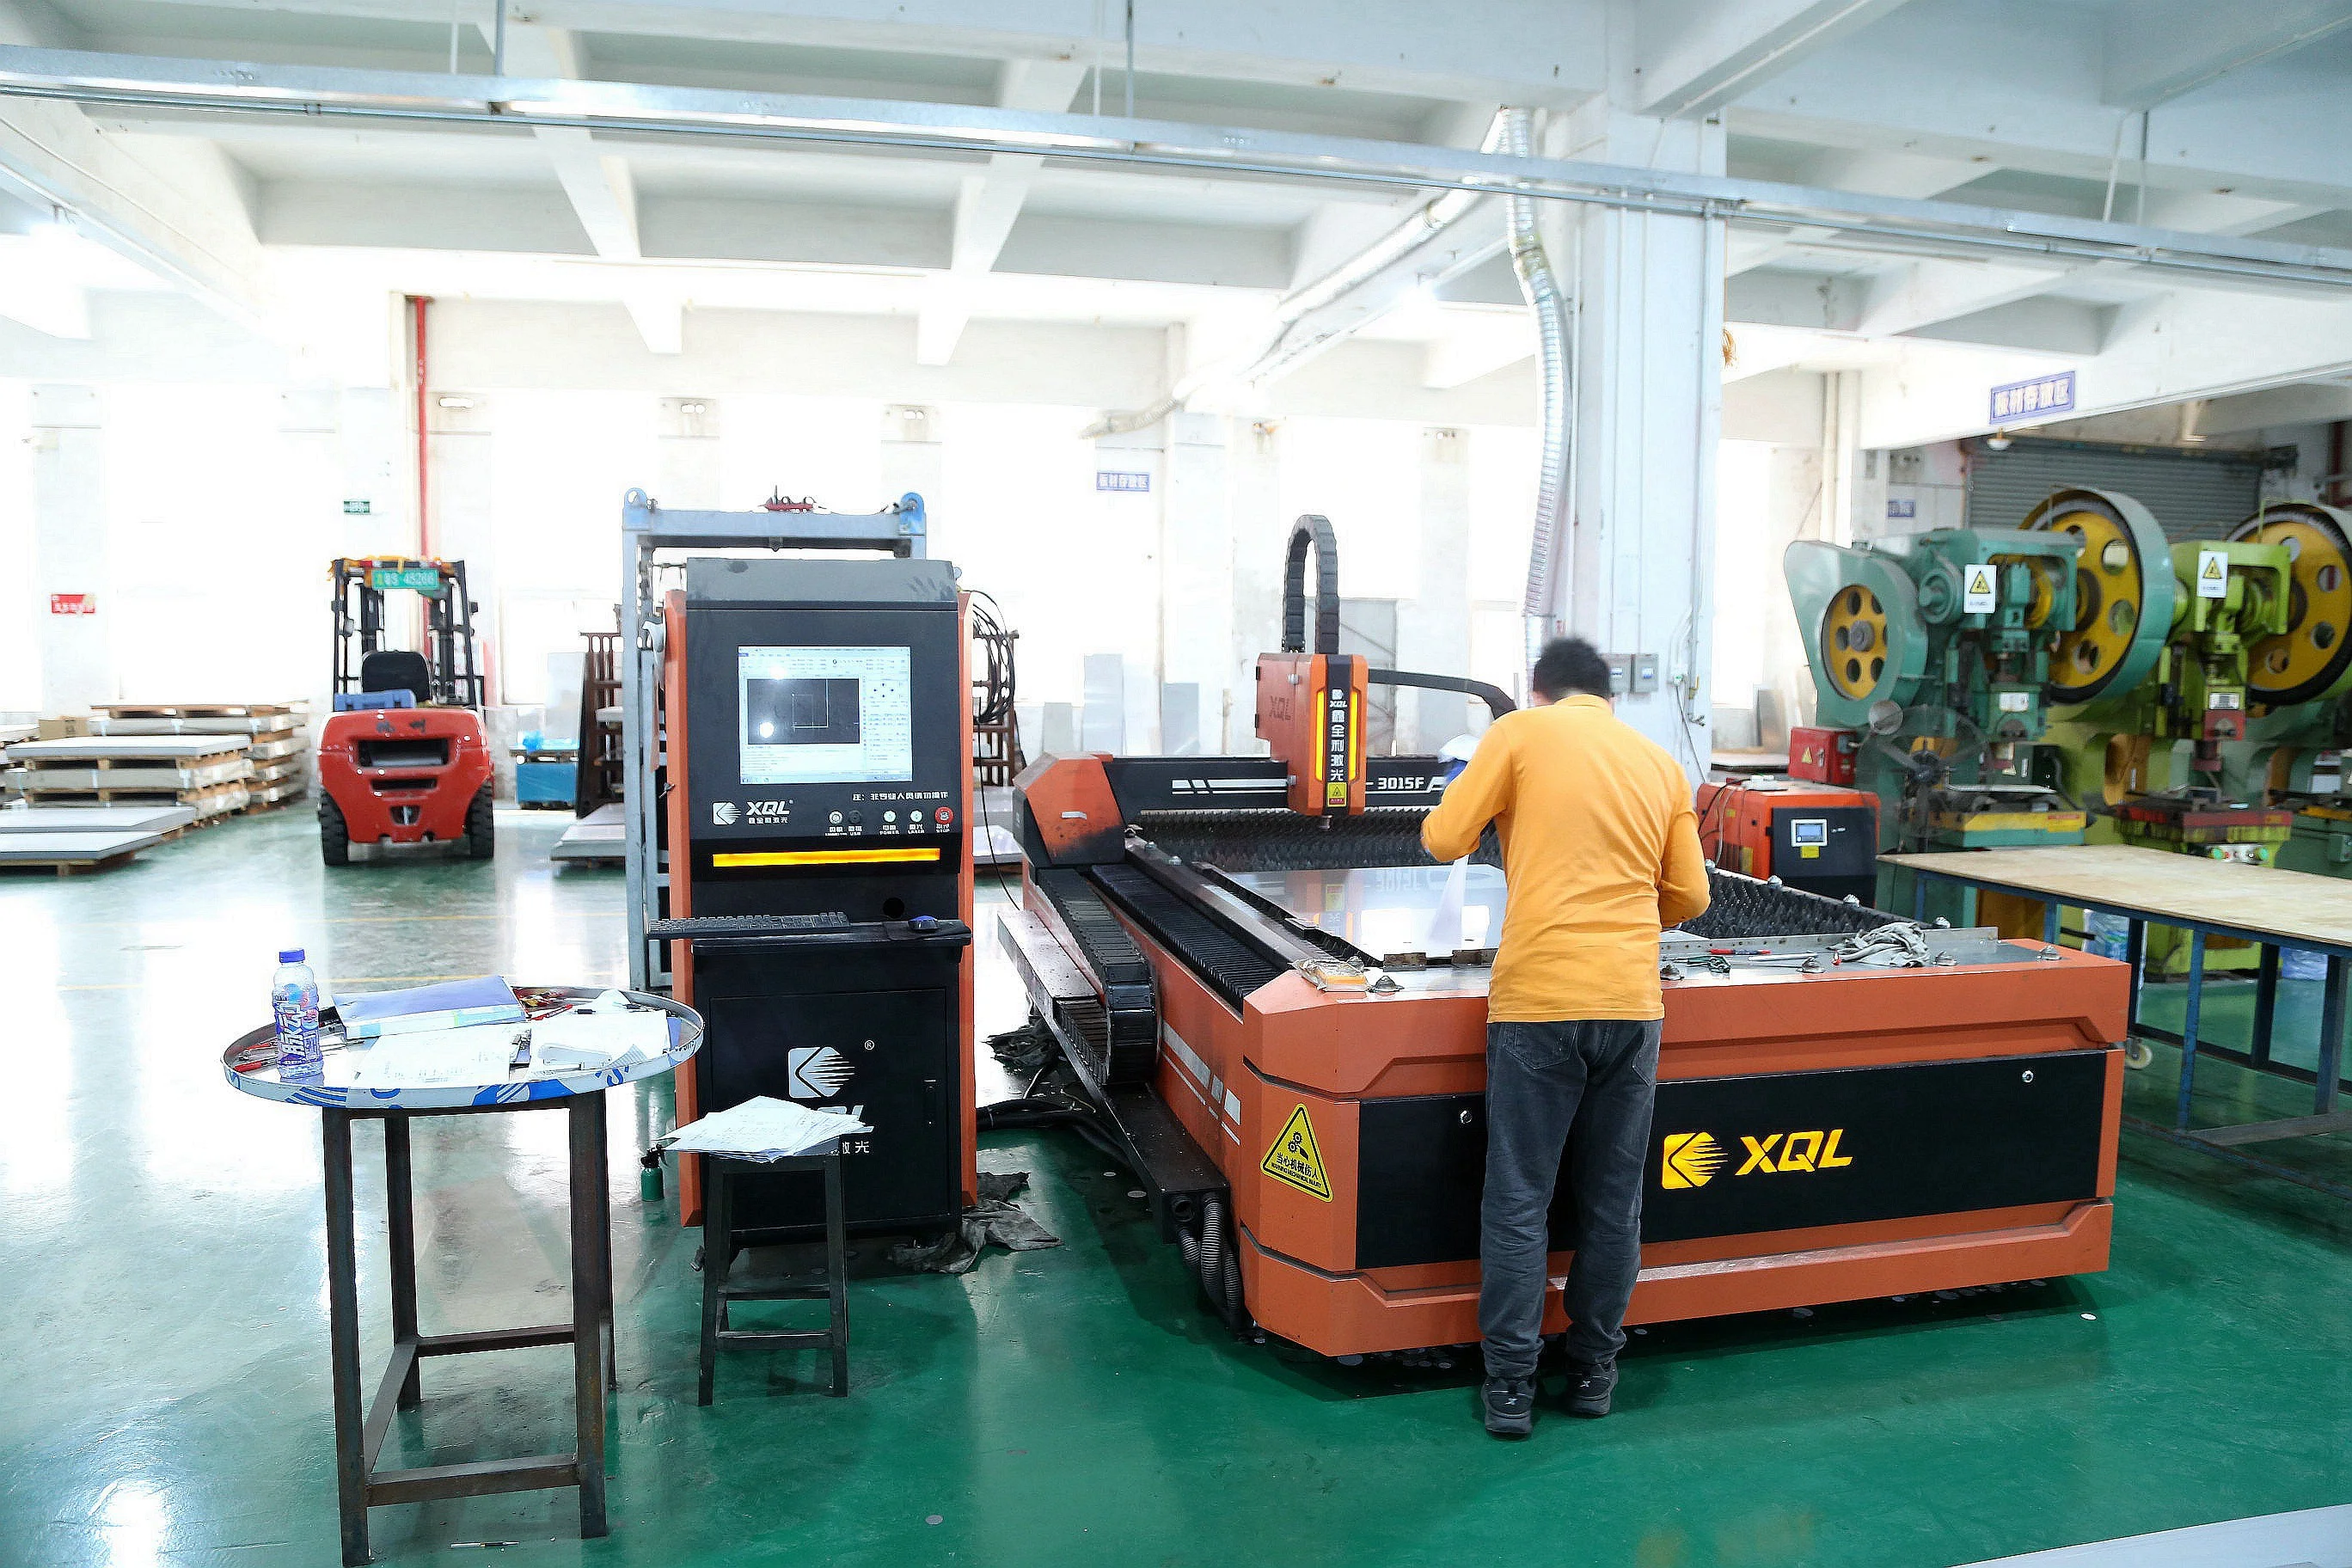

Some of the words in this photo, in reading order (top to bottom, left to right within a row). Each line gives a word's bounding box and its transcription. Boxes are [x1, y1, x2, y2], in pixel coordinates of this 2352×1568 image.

[745, 800, 790, 816] XQL
[276, 1001, 307, 1059] 脉动
[1277, 1152, 1319, 1180] 当心机械伤人
[1734, 1128, 1853, 1176] XQL
